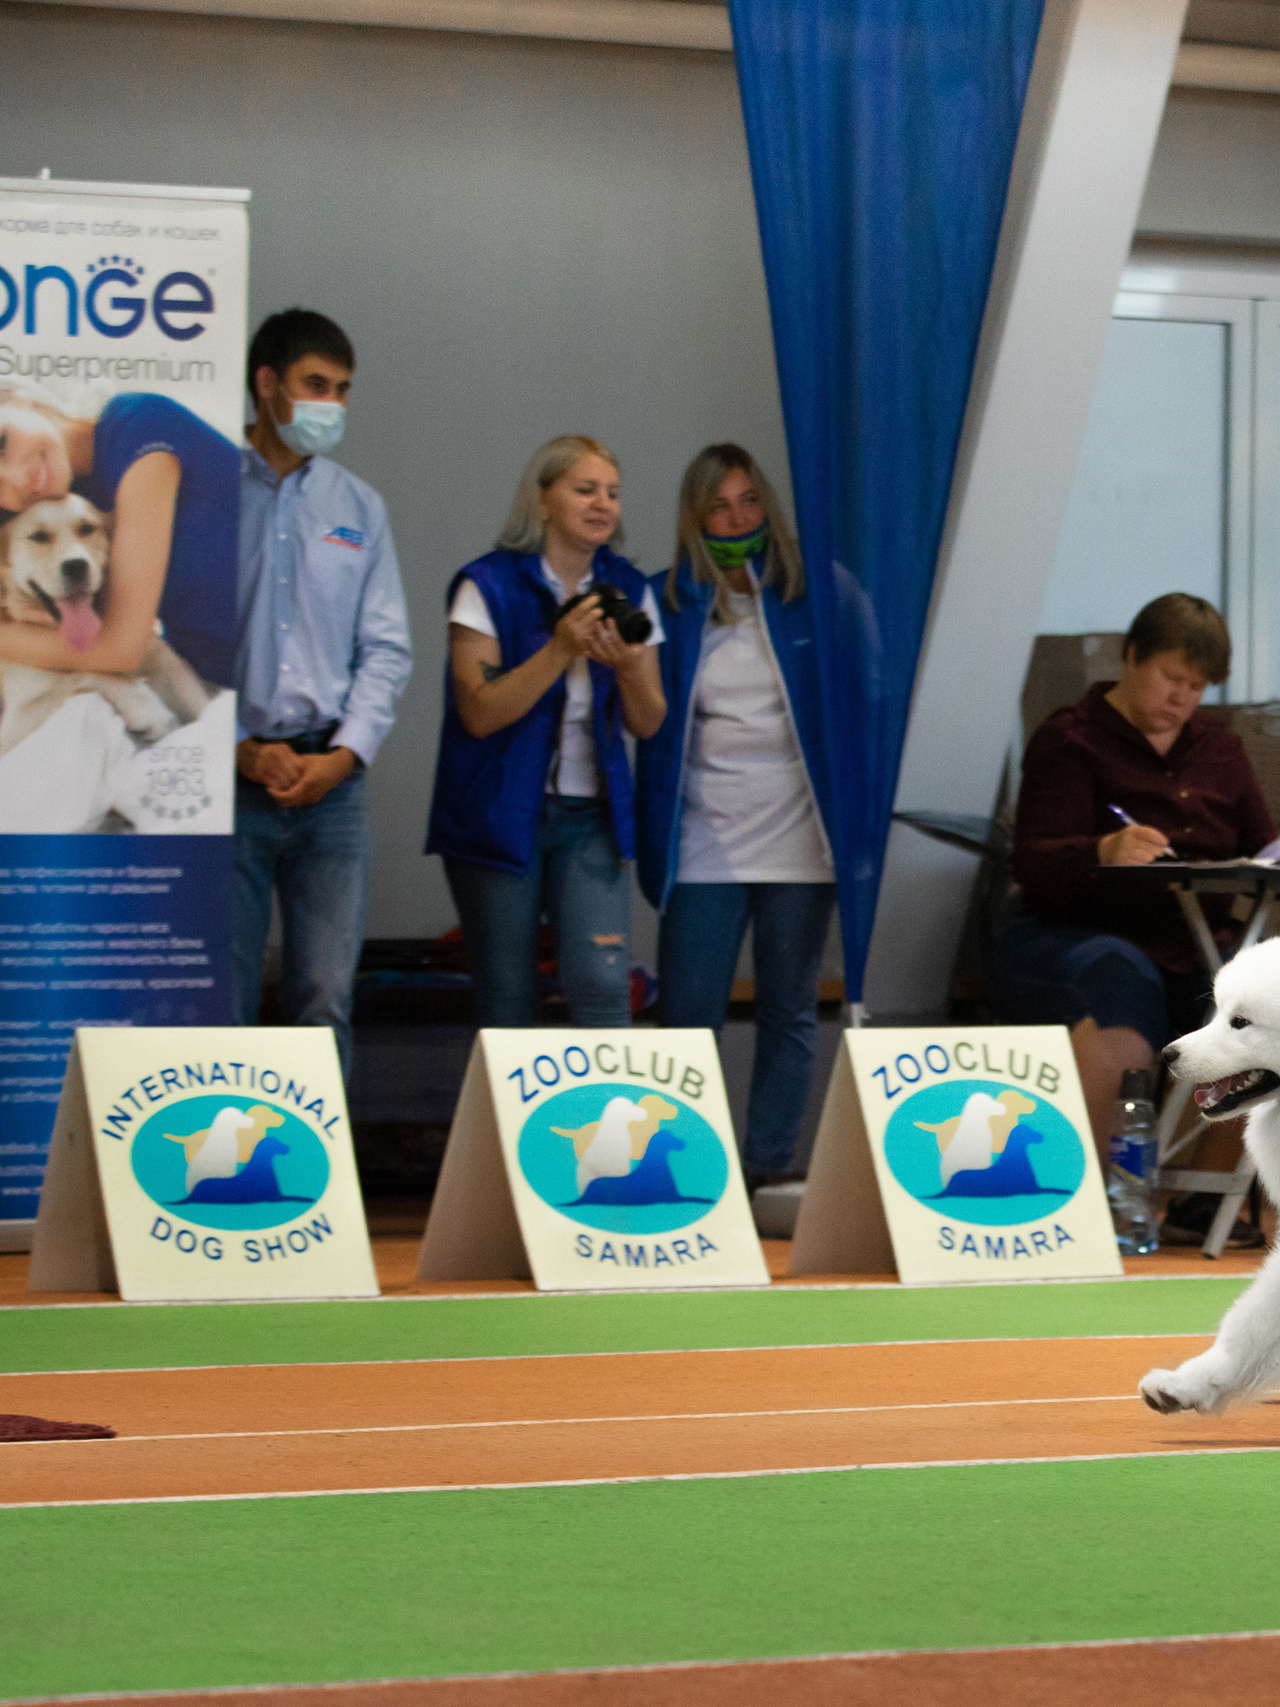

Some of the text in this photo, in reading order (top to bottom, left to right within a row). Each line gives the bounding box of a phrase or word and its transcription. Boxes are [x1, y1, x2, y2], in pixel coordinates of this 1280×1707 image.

[0, 219, 49, 236] орма
[0, 345, 215, 384] Superpremium
[507, 1043, 706, 1104] ZOOCLUB
[871, 1041, 1062, 1100] ZOOCLUB
[102, 1062, 341, 1141] INTERNATIONAL
[150, 1213, 334, 1263] DOG SHOW
[575, 1233, 719, 1269] SAMARA
[938, 1224, 1075, 1260] SAMARA
